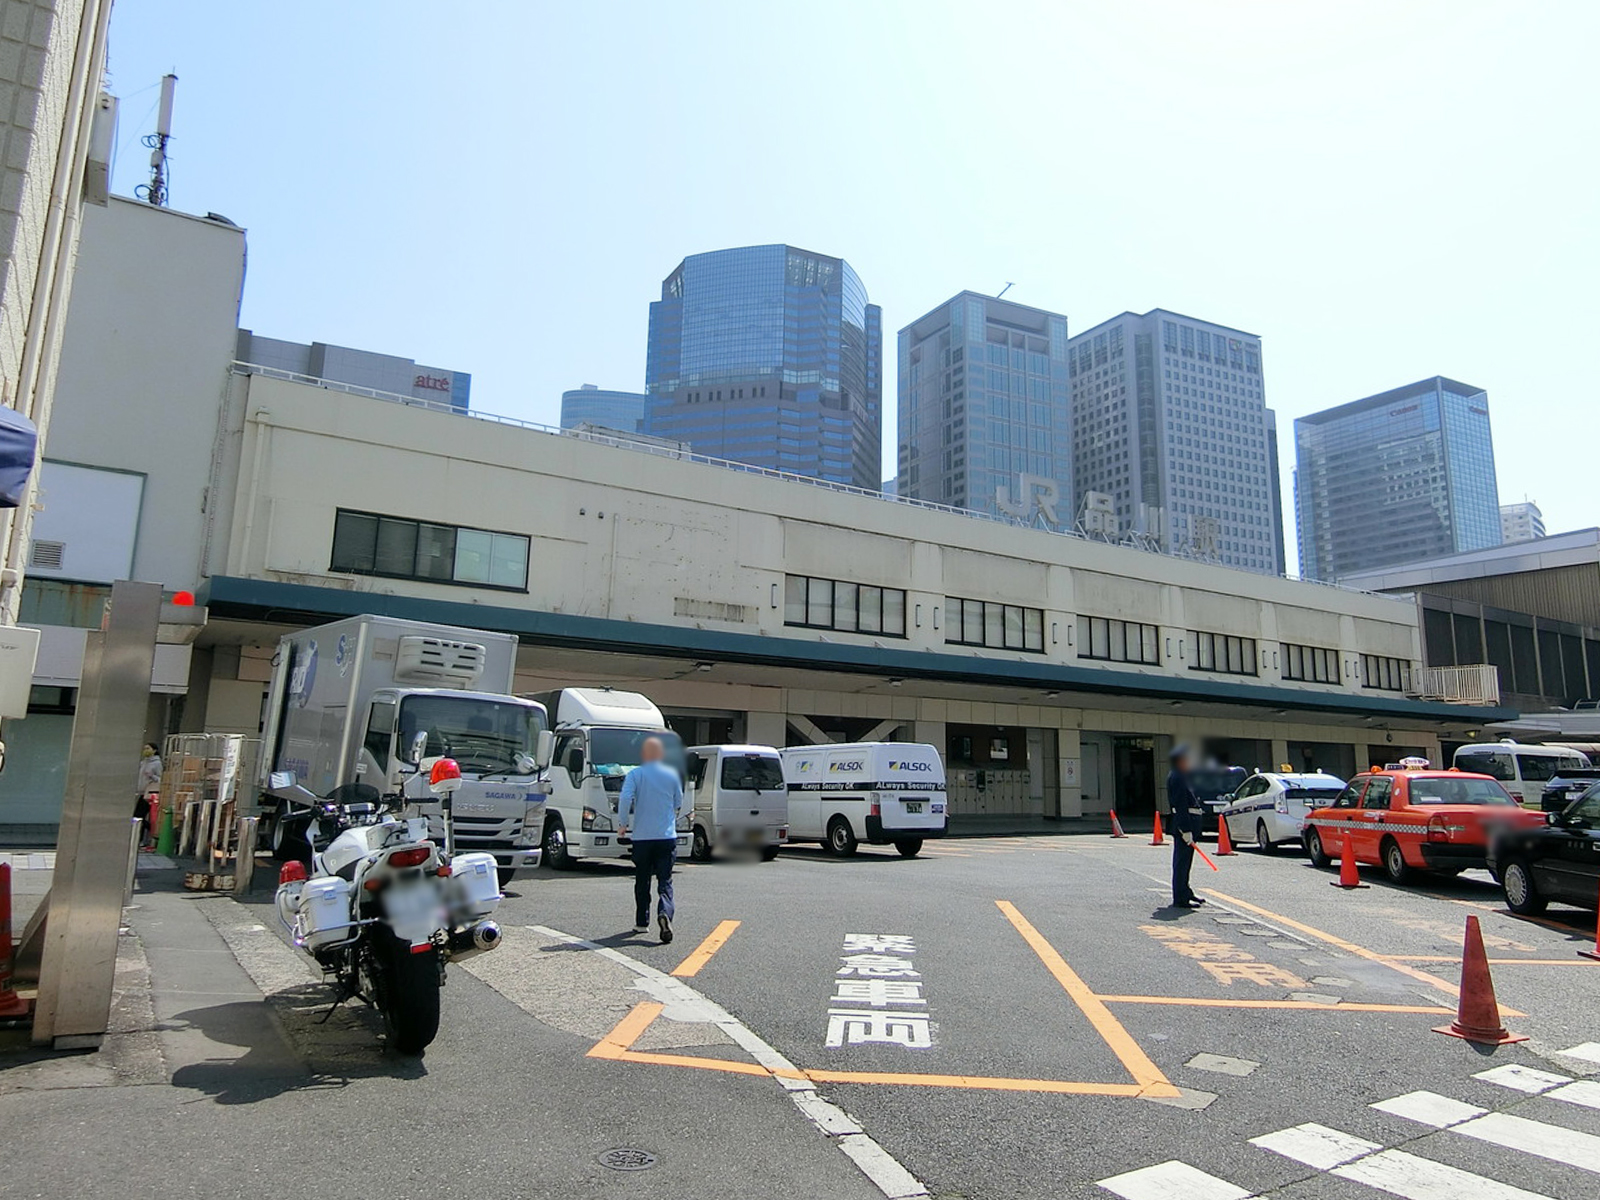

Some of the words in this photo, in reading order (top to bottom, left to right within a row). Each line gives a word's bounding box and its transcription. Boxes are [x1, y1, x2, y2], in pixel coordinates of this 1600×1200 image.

[414, 375, 450, 391] atré
[836, 761, 864, 771] ALSOK
[899, 761, 932, 772] ALSOK
[822, 782, 845, 791] Security
[907, 782, 936, 791] Security
[485, 791, 516, 800] SAGAWA
[825, 932, 933, 1050] 緊急車両
